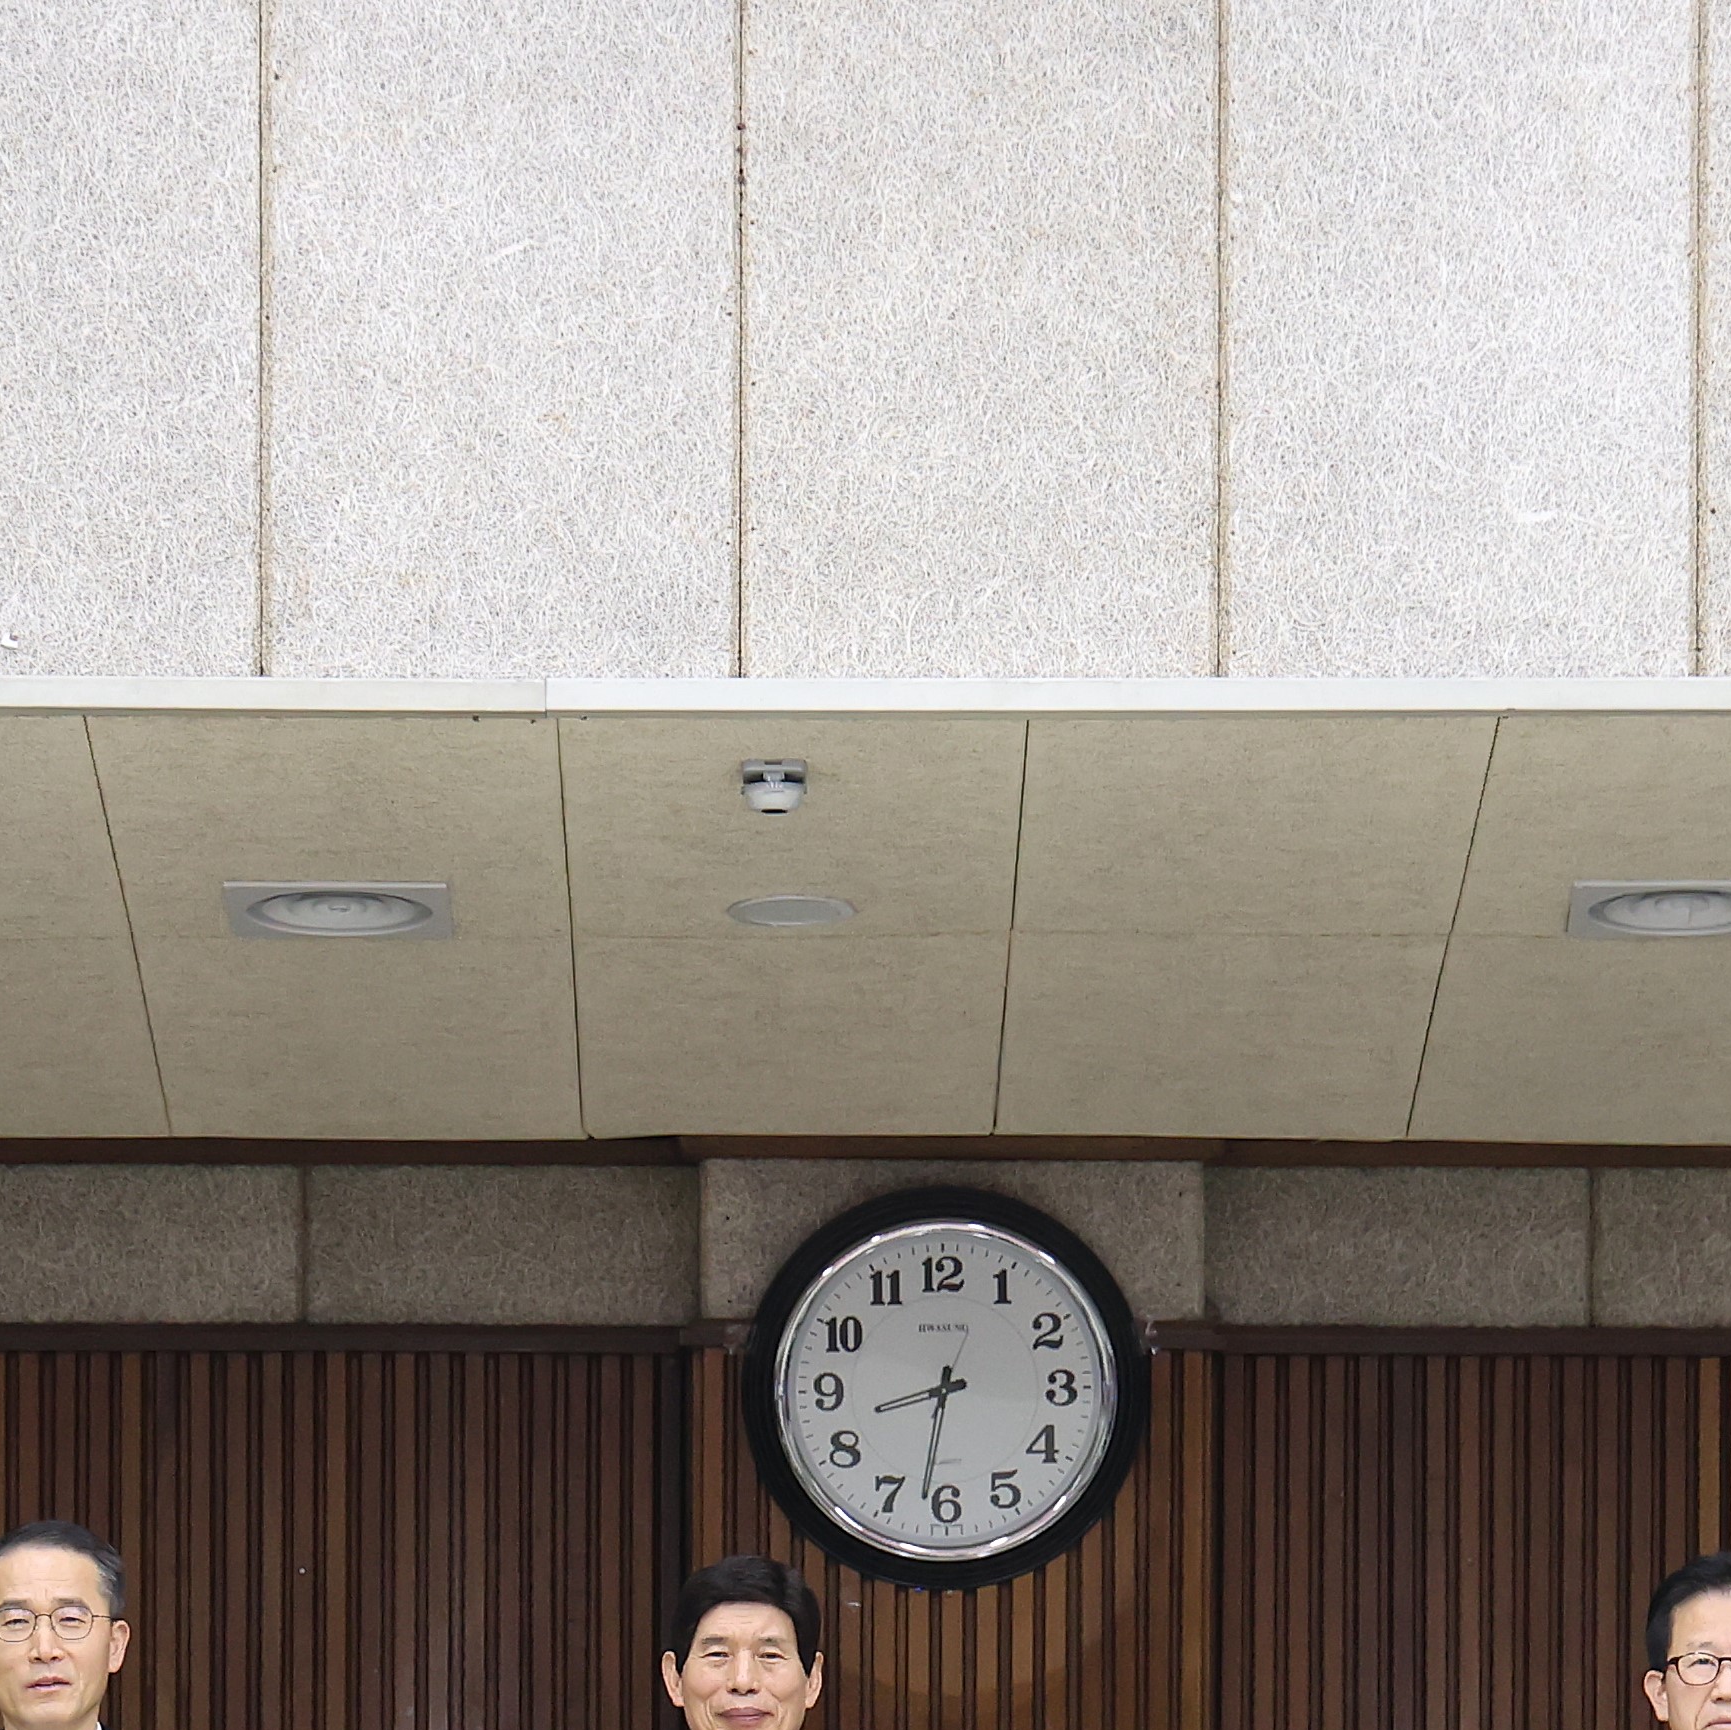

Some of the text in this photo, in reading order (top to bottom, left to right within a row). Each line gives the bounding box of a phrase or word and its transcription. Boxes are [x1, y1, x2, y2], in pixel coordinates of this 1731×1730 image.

[870, 1270, 903, 1306] 11
[922, 1256, 965, 1293] 12
[993, 1269, 1012, 1305] 1
[826, 1316, 862, 1353] 10
[1032, 1313, 1063, 1350] 2
[813, 1372, 844, 1411] 9
[1045, 1369, 1078, 1406] 3
[829, 1430, 861, 1468] 8
[1025, 1425, 1060, 1463] 4
[875, 1475, 905, 1513] 7
[931, 1485, 962, 1524] 6
[990, 1469, 1022, 1509] 5
